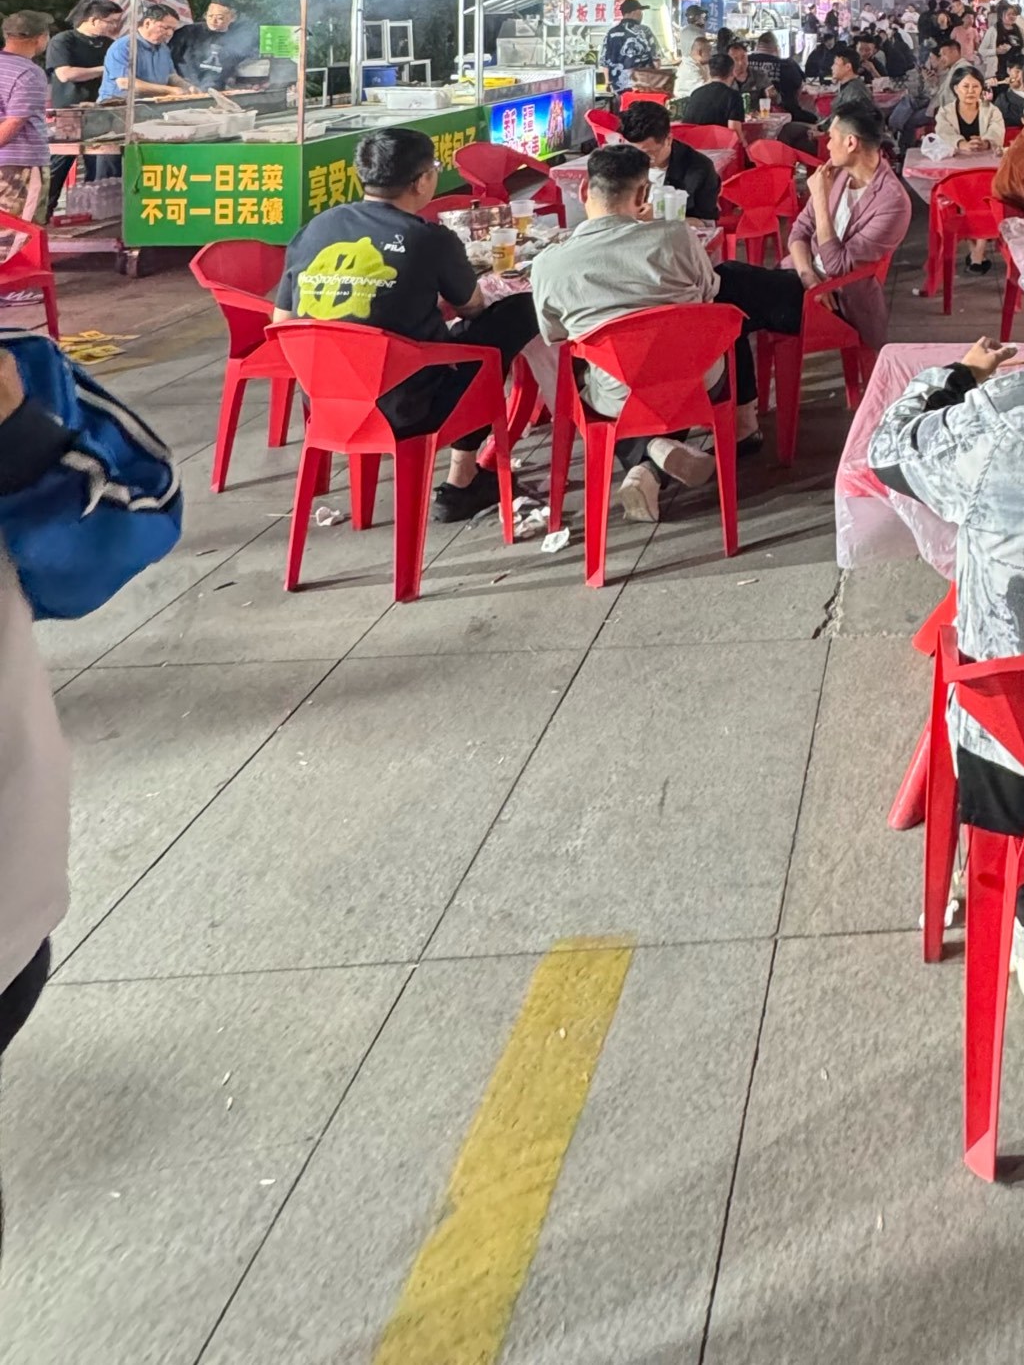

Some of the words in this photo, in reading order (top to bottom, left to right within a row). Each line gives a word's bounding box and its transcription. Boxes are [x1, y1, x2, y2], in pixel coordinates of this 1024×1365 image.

[141, 164, 283, 192] 可以一日无菜
[140, 197, 283, 225] 不可一日无馕
[384, 244, 405, 253] FILA
